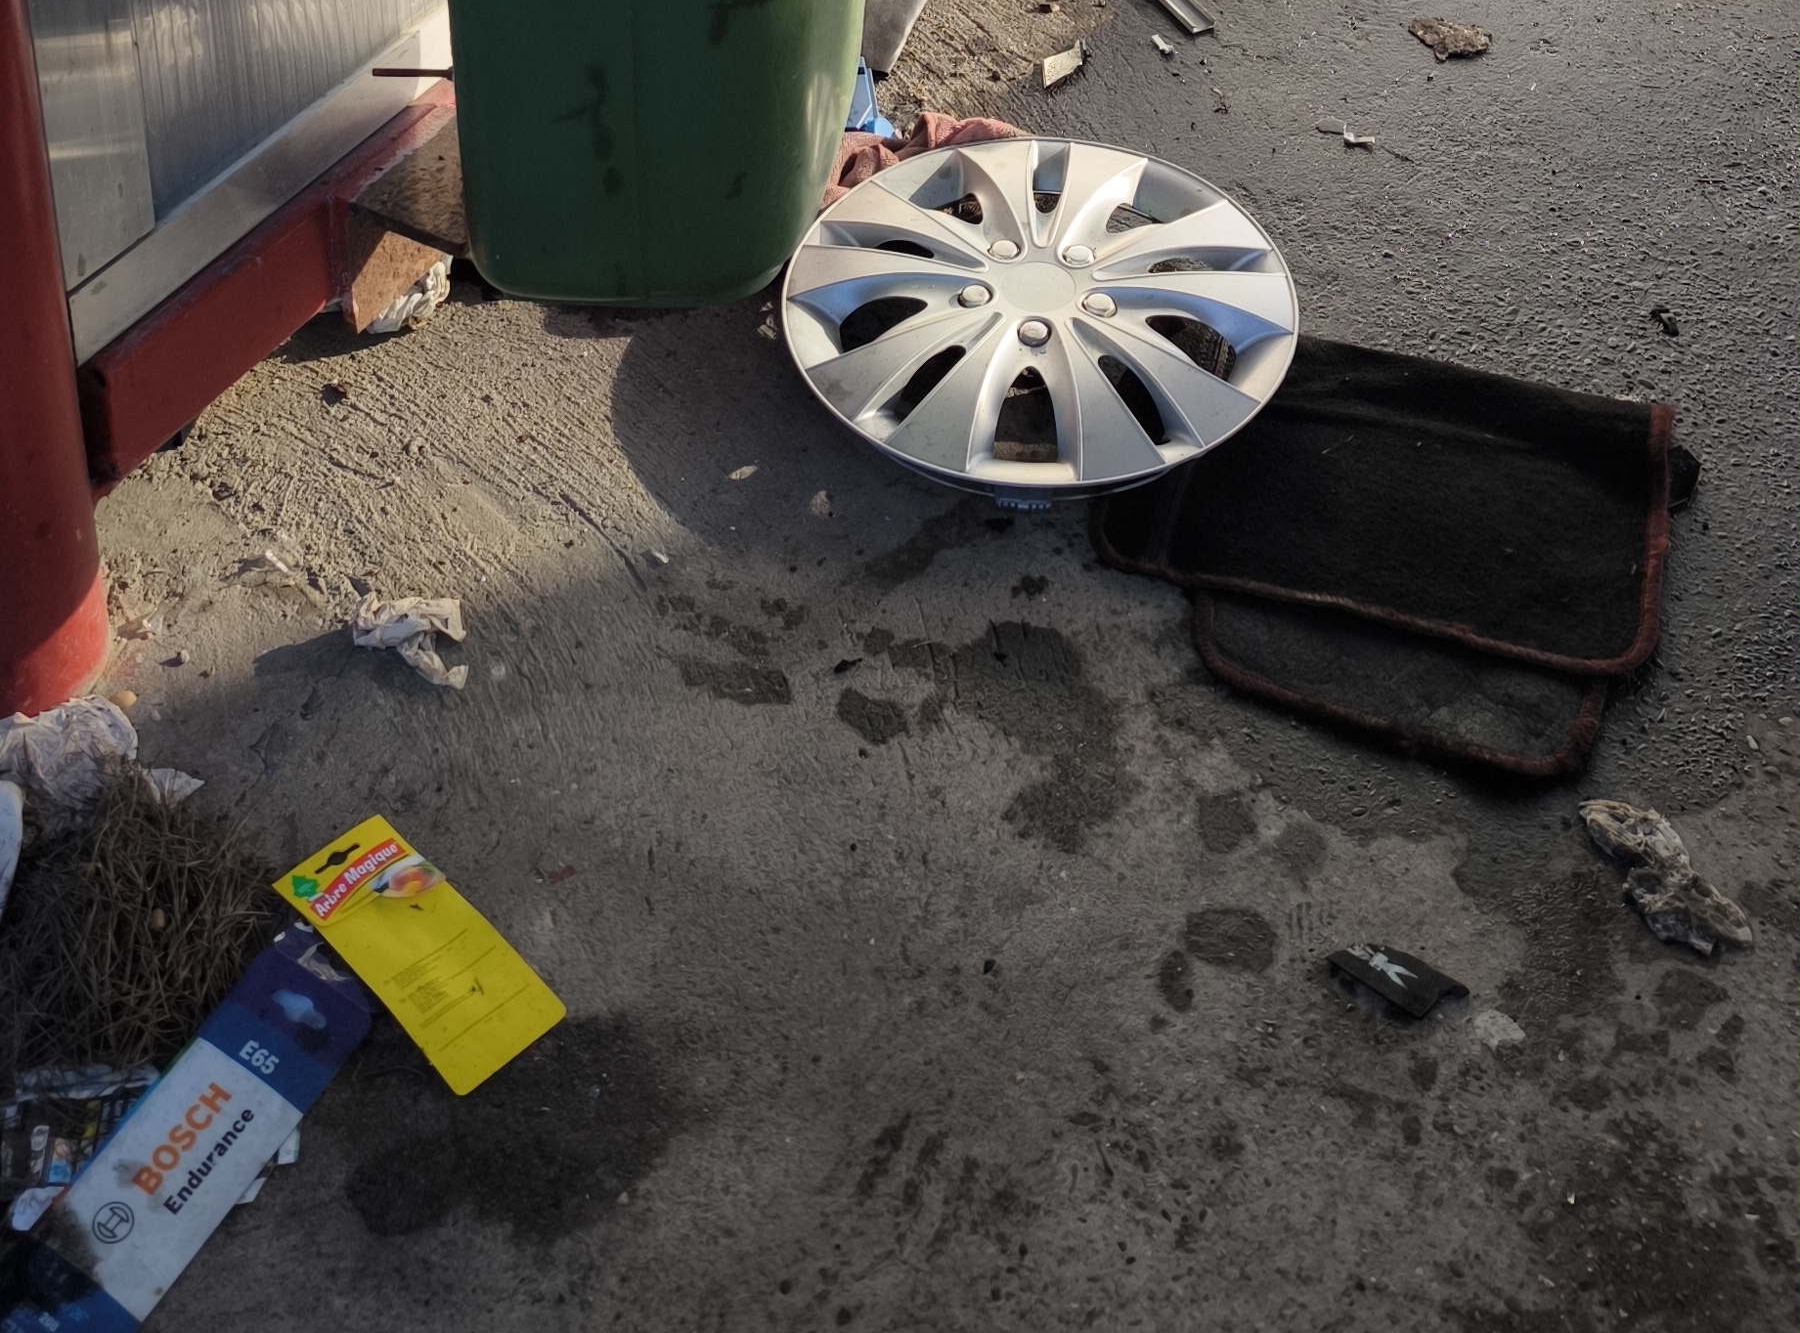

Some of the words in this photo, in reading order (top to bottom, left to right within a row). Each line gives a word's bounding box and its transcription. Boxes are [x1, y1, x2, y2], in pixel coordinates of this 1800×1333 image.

[314, 883, 348, 918] Arbre
[343, 842, 399, 885] Magique
[239, 1039, 280, 1075] E65
[131, 1082, 233, 1196] BOSCH
[163, 1108, 255, 1215] Endurance
